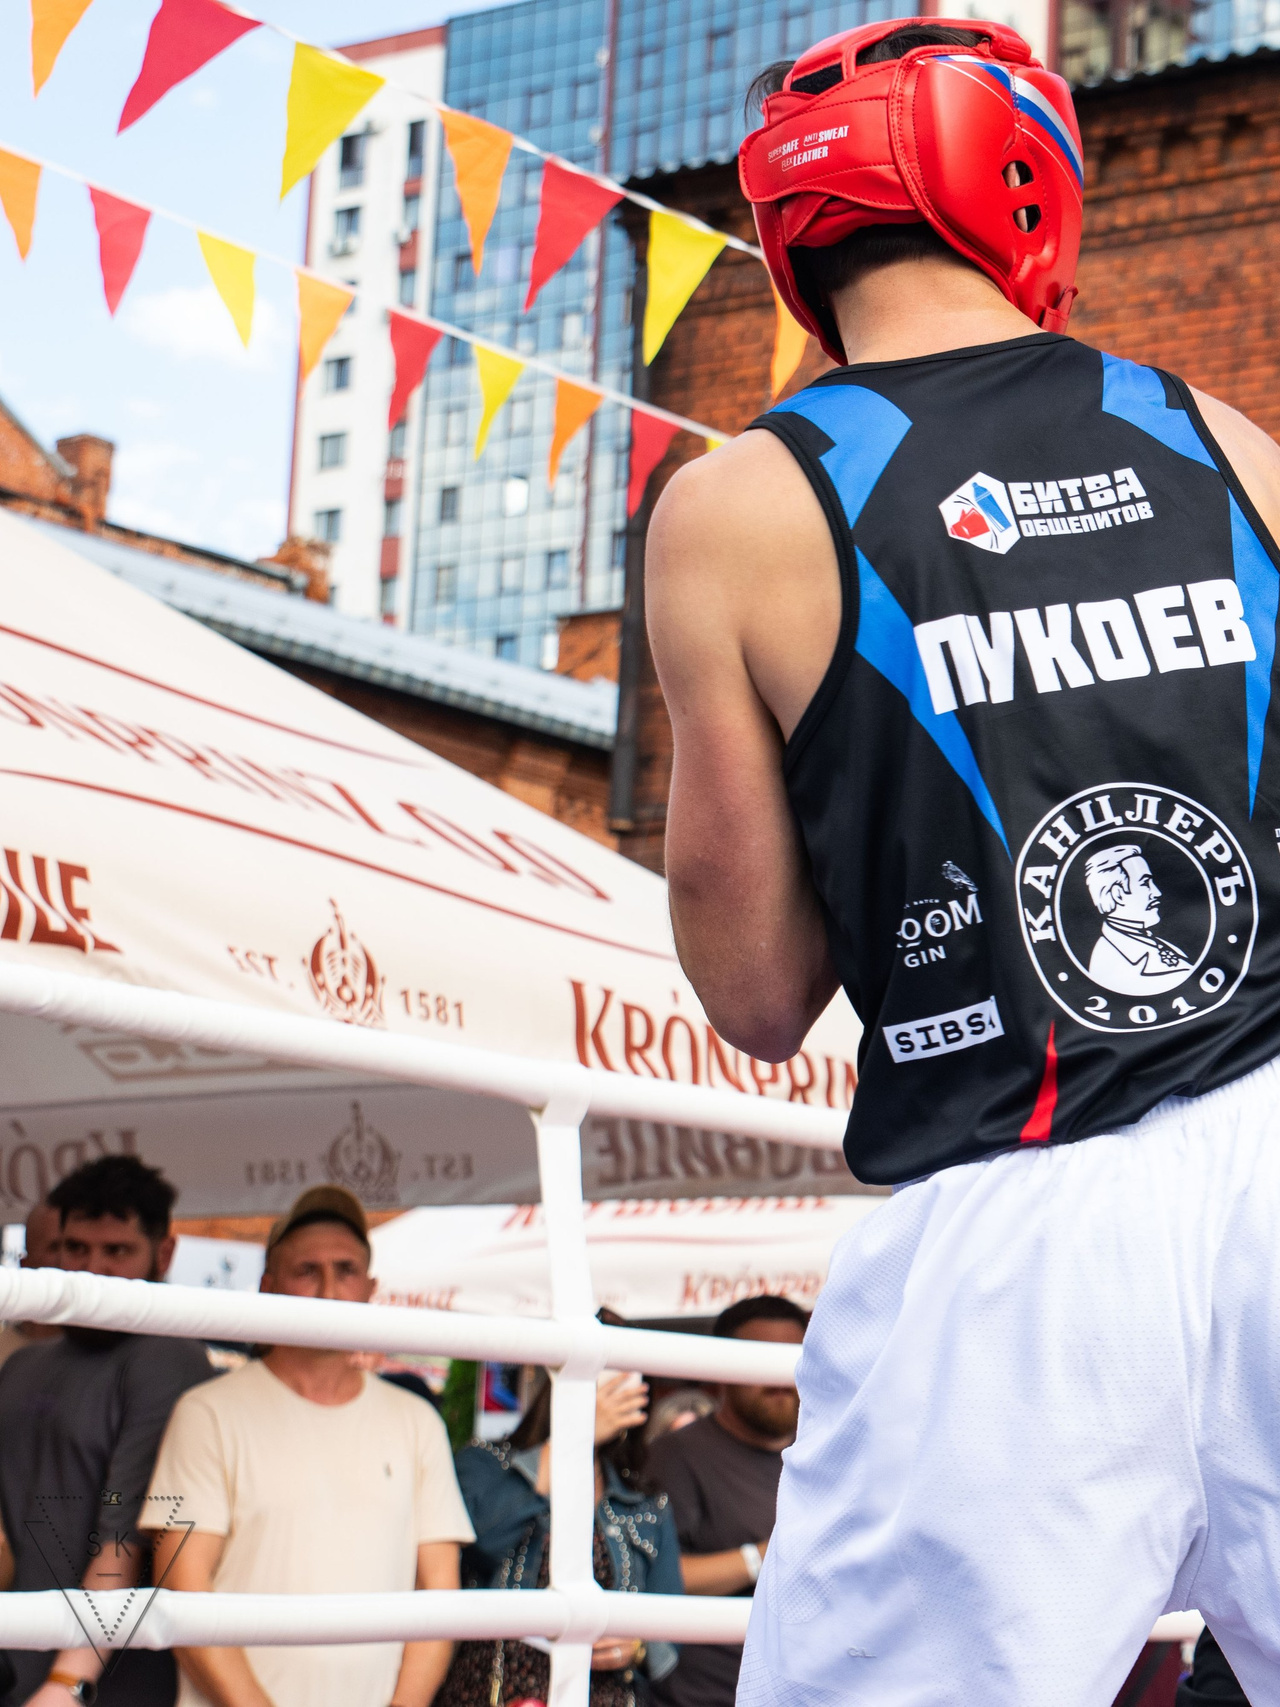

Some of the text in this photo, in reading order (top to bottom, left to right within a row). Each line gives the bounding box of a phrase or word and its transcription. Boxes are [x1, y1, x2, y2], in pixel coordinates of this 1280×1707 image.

[1008, 467, 1149, 515] БИТВА
[1019, 501, 1154, 538] ОБЩЕПИТОВ
[913, 578, 1257, 715] ПУКОЕВ
[1023, 792, 1247, 944] КАНЦЛЕРЪ
[897, 893, 983, 942] OOM
[904, 945, 947, 968] GIN
[399, 987, 466, 1030] 1581
[1084, 966, 1226, 1024] 2010
